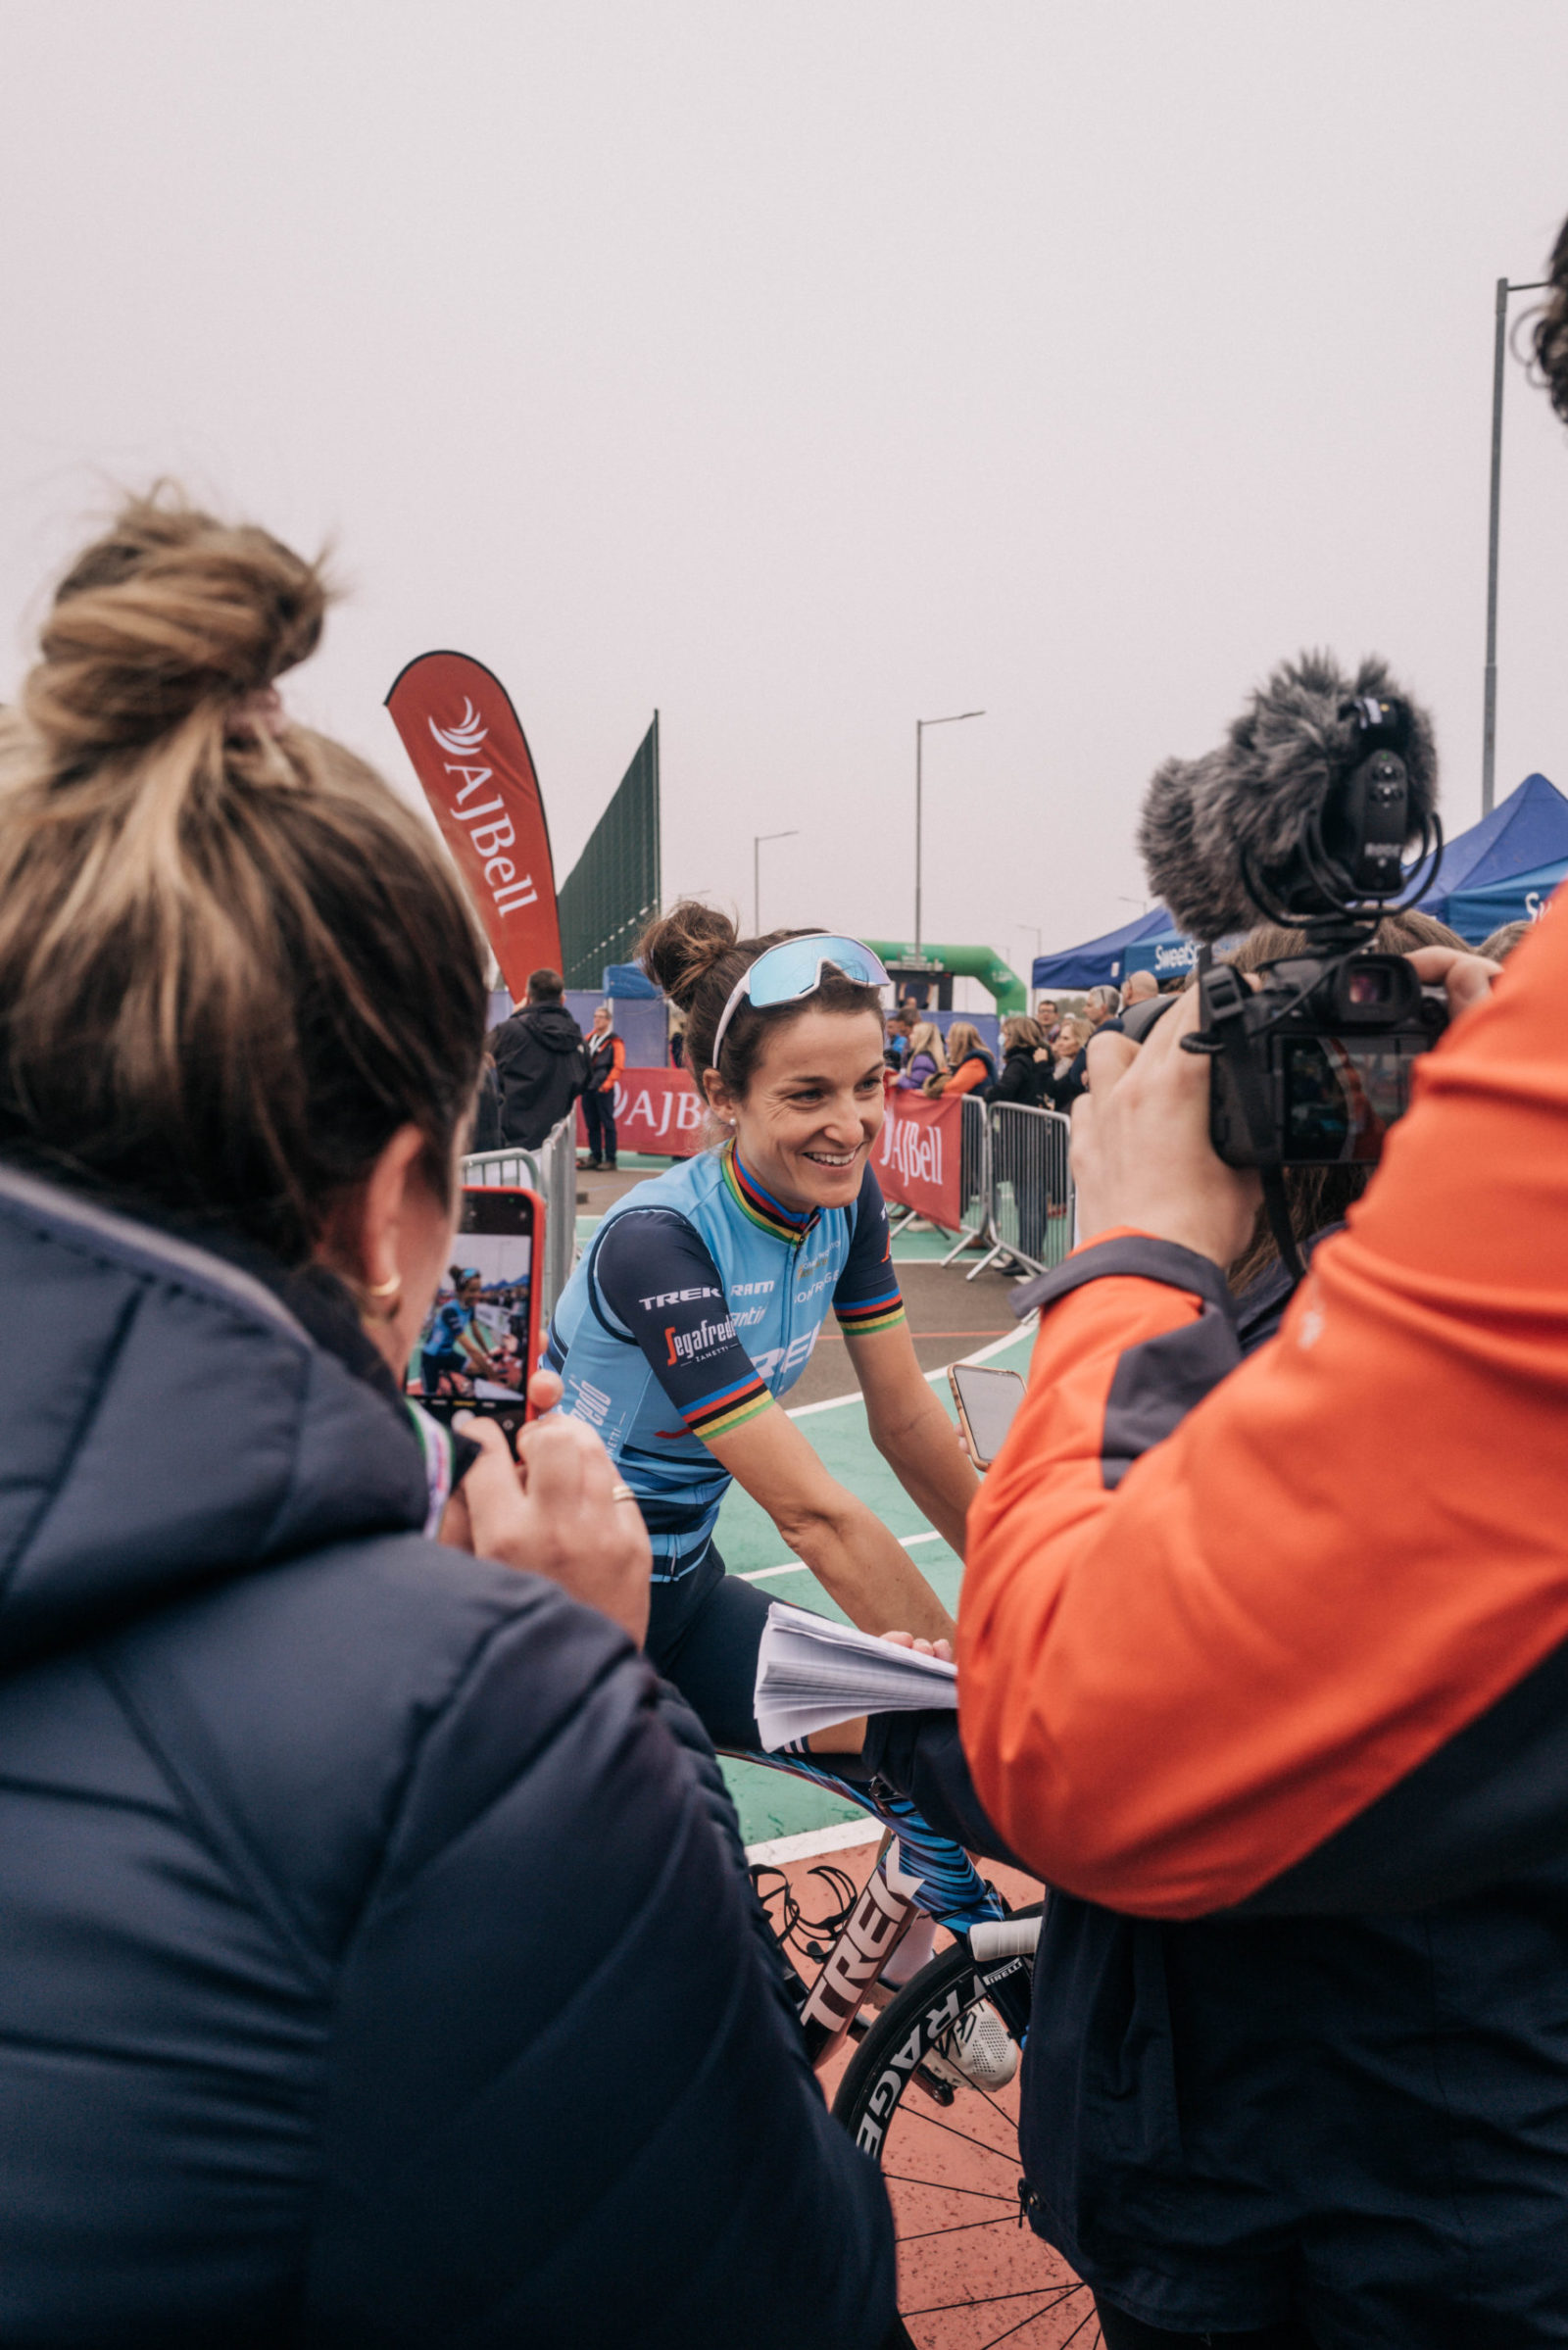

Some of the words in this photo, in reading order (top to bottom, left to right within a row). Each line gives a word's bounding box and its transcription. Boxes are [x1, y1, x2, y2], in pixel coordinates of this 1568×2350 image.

[623, 1089, 702, 1137] AJB
[638, 1287, 722, 1311] TREK
[730, 1281, 775, 1297] RAM
[695, 1346, 729, 1362] ZANETTI
[800, 1835, 926, 2032] TREK
[982, 1957, 1023, 1986] PIRELLI
